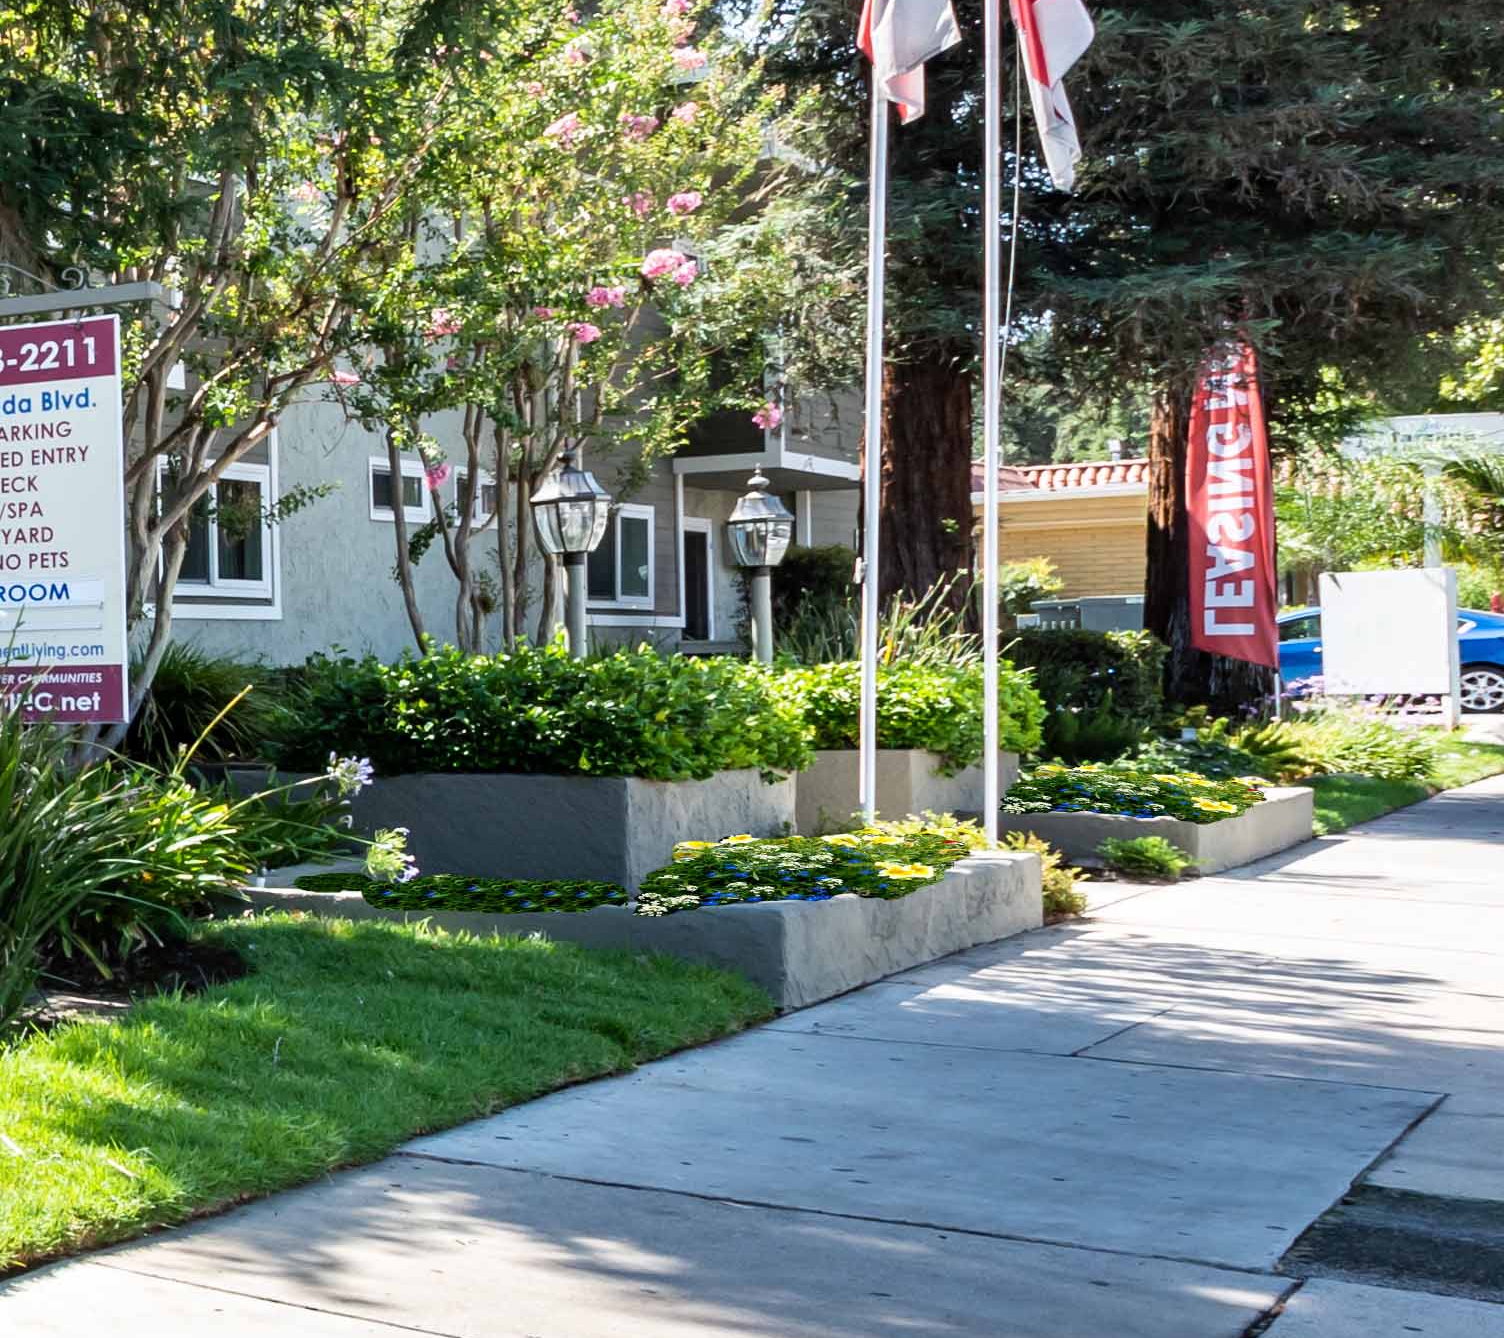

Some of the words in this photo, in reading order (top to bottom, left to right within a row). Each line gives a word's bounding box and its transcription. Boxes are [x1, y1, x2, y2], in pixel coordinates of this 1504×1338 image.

[41, 387, 98, 412] Blvd.
[31, 445, 90, 466] ENTRY
[28, 551, 69, 569] PETS
[17, 672, 103, 685] CMUNITIES
